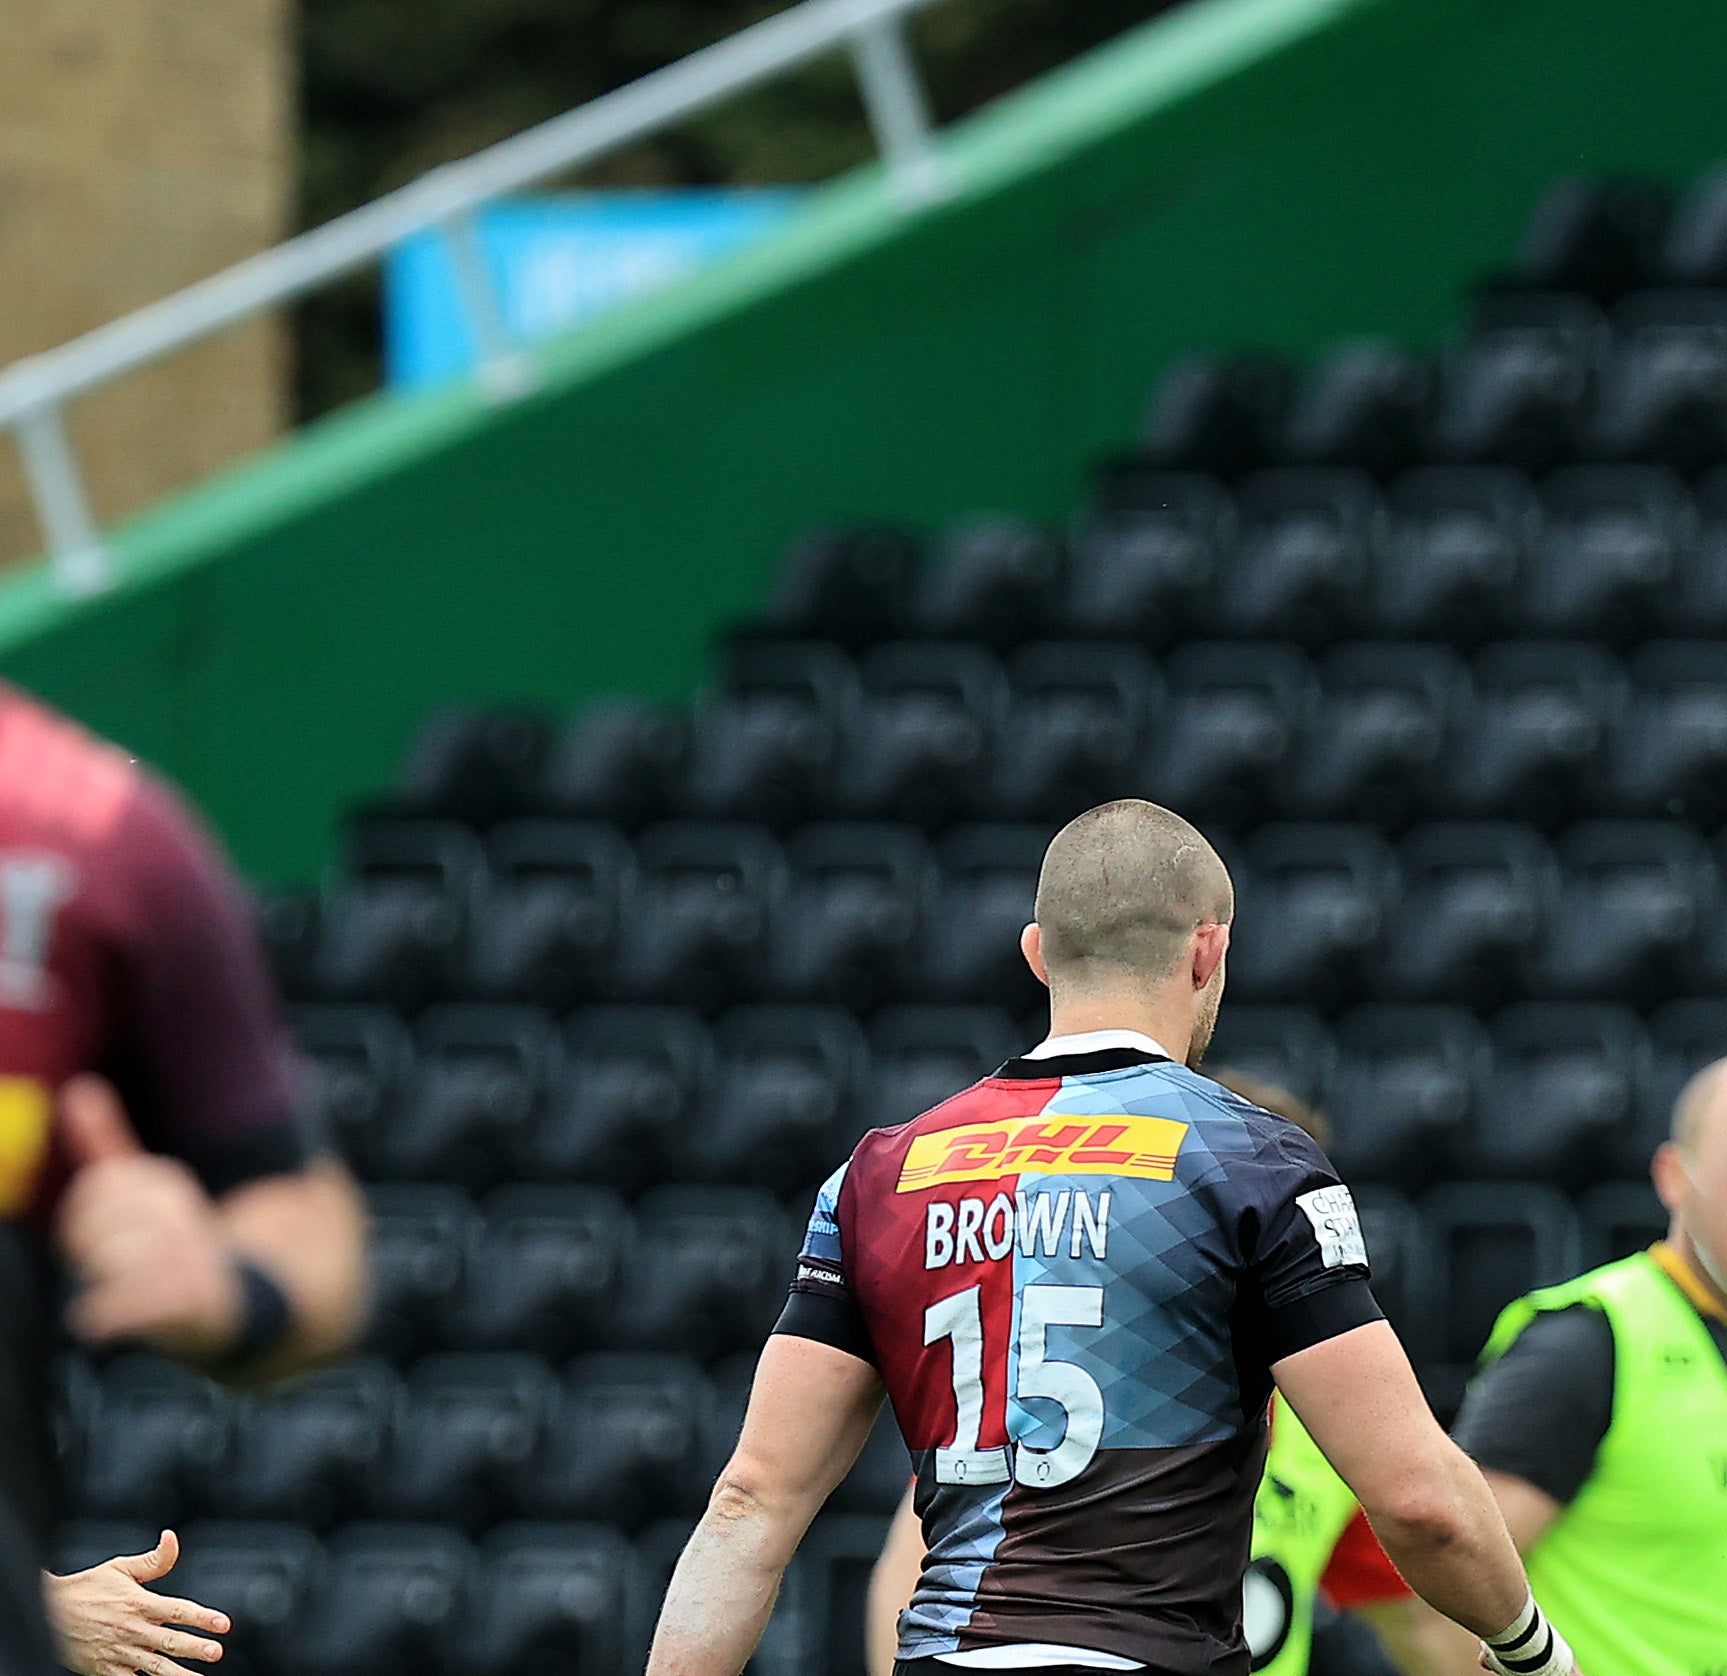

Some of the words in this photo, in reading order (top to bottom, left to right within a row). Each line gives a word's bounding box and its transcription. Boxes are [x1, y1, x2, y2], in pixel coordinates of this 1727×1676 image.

[934, 1123, 1135, 1176] DHL
[924, 1190, 1111, 1270] BROWN
[924, 1284, 1105, 1488] 15
